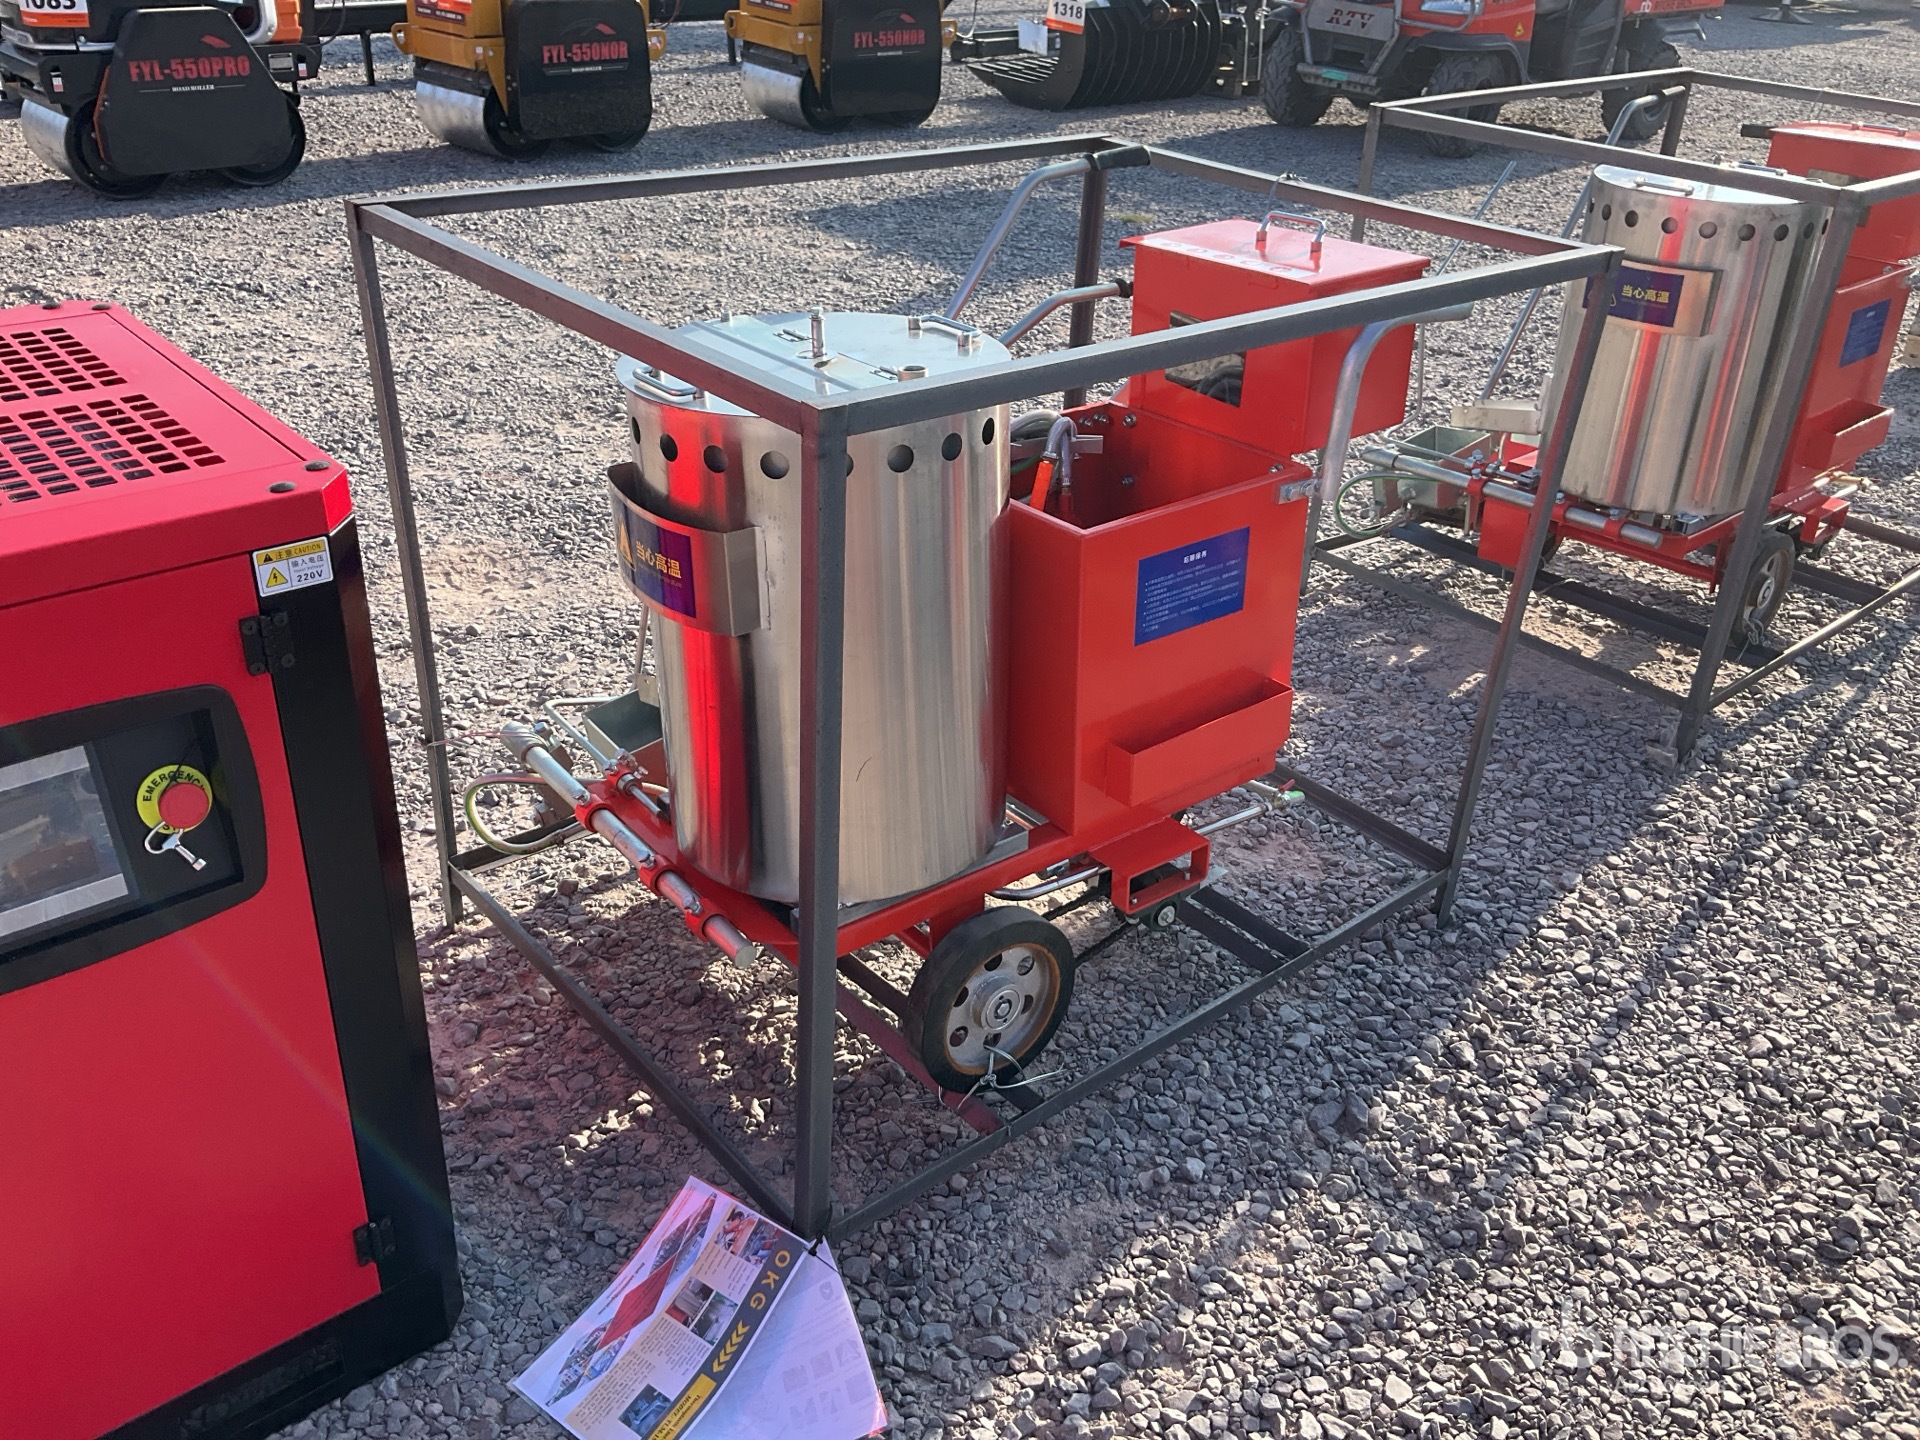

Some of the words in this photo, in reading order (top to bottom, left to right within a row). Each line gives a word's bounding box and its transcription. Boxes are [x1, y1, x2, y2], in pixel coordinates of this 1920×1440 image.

[1053, 2, 1083, 19] 1318
[1326, 8, 1375, 29] RTV
[128, 56, 250, 81] FYL-550PRO
[1621, 284, 1670, 303] 当心高温
[293, 543, 322, 555] CAUTION
[635, 540, 682, 579] 当心高温
[296, 569, 323, 583] 220V
